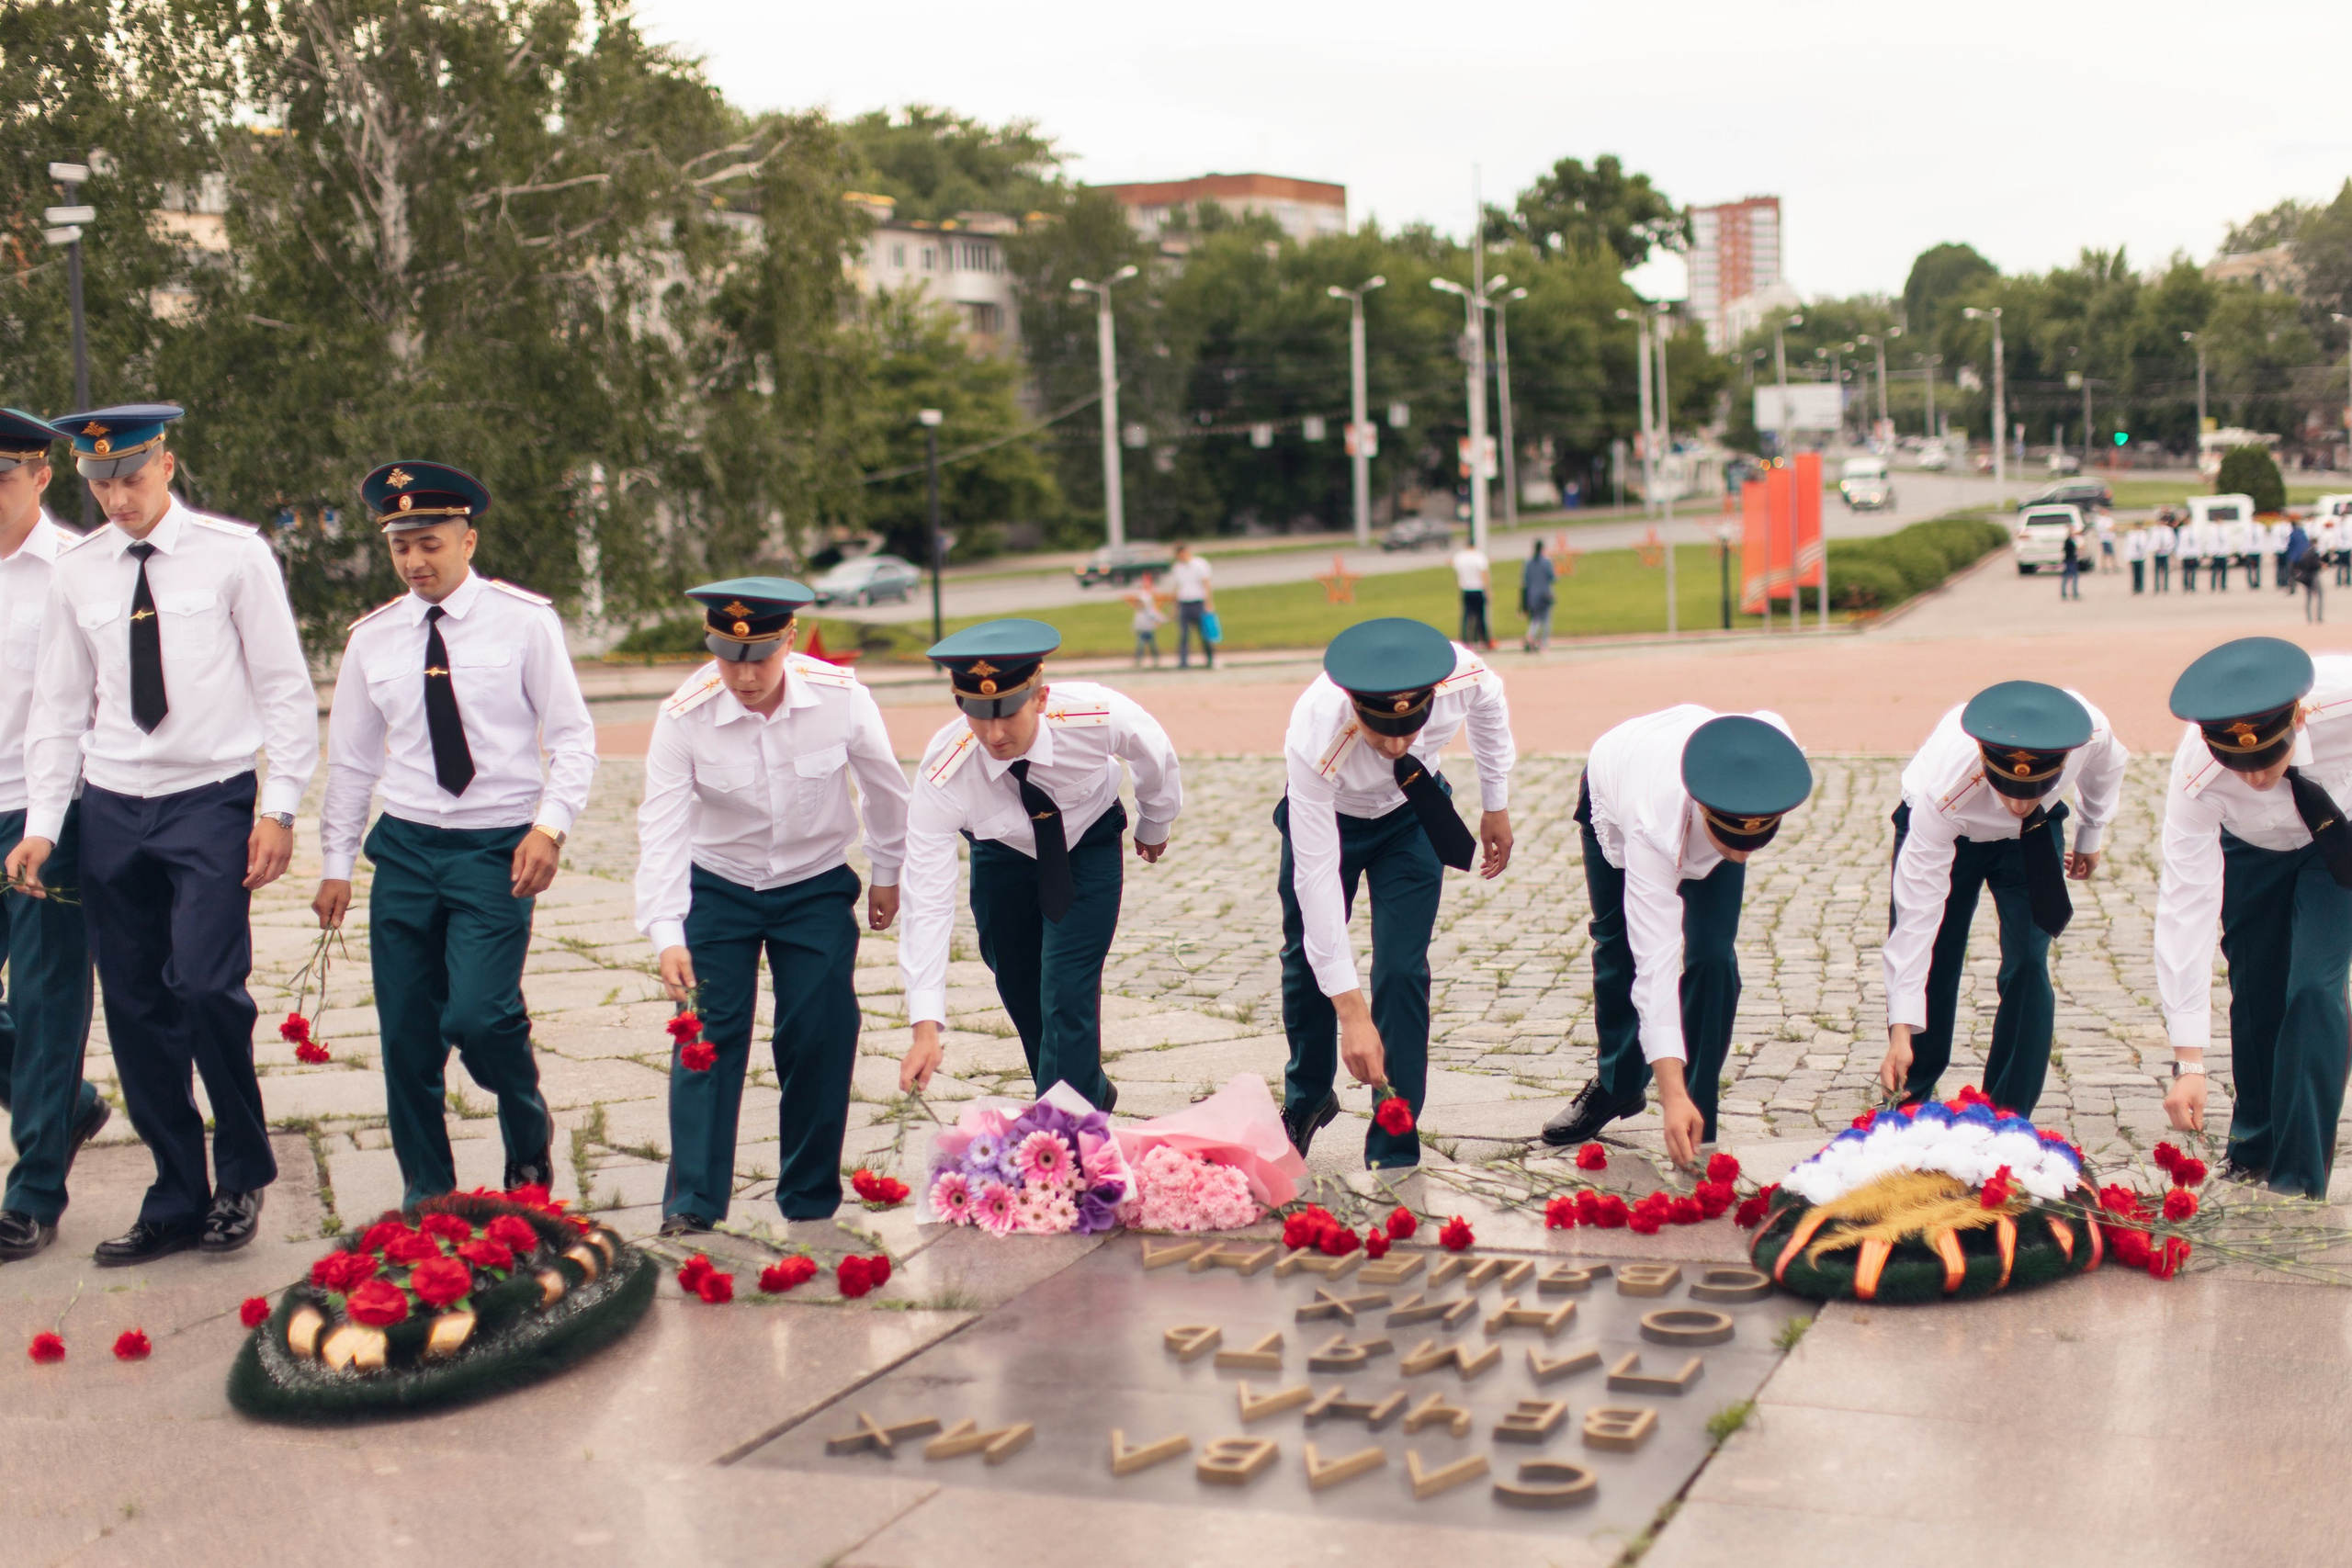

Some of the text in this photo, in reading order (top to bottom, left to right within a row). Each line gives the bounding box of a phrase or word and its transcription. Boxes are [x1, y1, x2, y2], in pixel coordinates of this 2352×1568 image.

[1295, 1288, 1735, 1345] О НИХ
[1164, 1325, 1704, 1394] ПАМЯТЬ
[1238, 1382, 1658, 1450] ВЕЧНА
[825, 1410, 1600, 1508] СЛАВА ИХ
